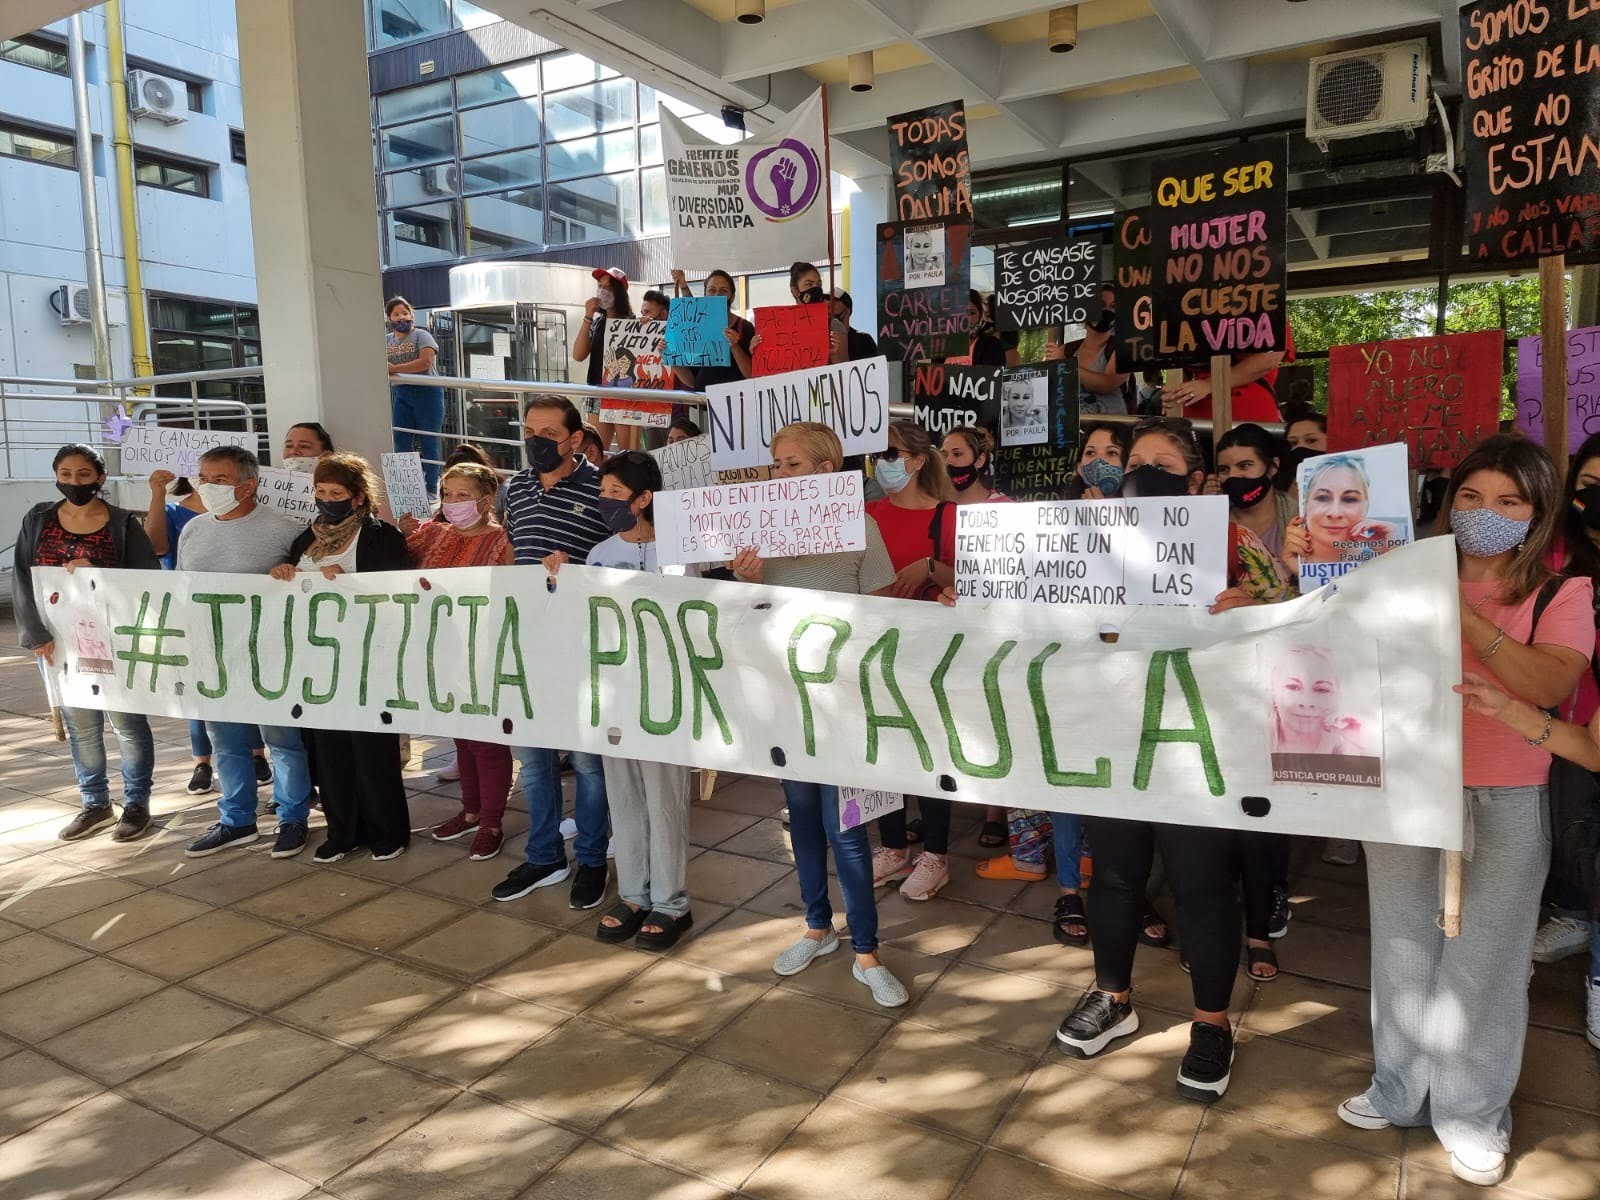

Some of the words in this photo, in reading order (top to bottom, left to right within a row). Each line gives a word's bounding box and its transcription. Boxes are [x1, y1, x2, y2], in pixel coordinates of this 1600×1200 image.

[1465, 0, 1550, 51] SOMOS
[1534, 43, 1565, 78] DE
[1473, 104, 1512, 138] QUE
[1534, 93, 1570, 126] NO
[891, 111, 965, 147] TODAS
[686, 149, 722, 161] FRENTE
[725, 149, 740, 159] DE
[897, 150, 969, 188] SOMOS
[717, 183, 740, 196] MUP
[1157, 173, 1216, 208] QUE
[1223, 160, 1273, 197] SER
[678, 196, 745, 214] DIVERSIDAD
[678, 214, 695, 228] LA
[698, 214, 755, 229] PAMPA
[1170, 210, 1267, 251] MUJER
[997, 251, 1019, 270] TE
[1022, 241, 1097, 267] CANSASTE
[1166, 253, 1204, 285] NO
[1213, 245, 1272, 282] NOS
[1000, 270, 1023, 287] DE
[1083, 264, 1095, 280] Y
[884, 287, 967, 318] CARCEL
[997, 283, 1069, 307] NOSOTRAS
[1072, 282, 1097, 299] DE
[1181, 283, 1281, 316] CUESTE
[609, 319, 622, 333] SI
[625, 321, 642, 334] UN
[879, 322, 900, 338] AL
[1158, 320, 1197, 354] LA
[608, 334, 648, 350] FALTO
[899, 338, 926, 363] YA
[1361, 346, 1393, 376] YO
[1408, 345, 1450, 371] NO
[915, 366, 944, 396] NO
[949, 370, 1001, 400] NACÍ
[1010, 370, 1042, 381] JUSTICIA
[1366, 373, 1463, 402] MUERO
[807, 362, 883, 440] MENOS
[1423, 402, 1463, 426] ME
[136, 428, 153, 444] TE
[159, 430, 221, 449] CANSAS
[1006, 429, 1020, 437] POR
[1024, 426, 1046, 435] PAULA
[1033, 445, 1052, 457] UN
[274, 479, 295, 492] QUE
[681, 491, 696, 510] SI
[702, 489, 723, 507] NO
[729, 479, 819, 505] ENTIENDES
[828, 475, 855, 497] LOS
[689, 510, 751, 532] MOTIVOS
[759, 508, 778, 528] DE
[784, 511, 801, 527] LA
[809, 500, 865, 523] MARCHA
[959, 509, 998, 528] TODAS
[1037, 507, 1069, 526] PERO
[1074, 506, 1139, 527] NINGUNO
[1163, 506, 1189, 527] NO
[682, 535, 697, 552] ES
[702, 530, 745, 549] PORQUE
[751, 529, 787, 545] ERES
[793, 526, 842, 541] PARTE
[769, 540, 844, 556] PROBLEMA
[958, 532, 1025, 553] TENEMOS
[1036, 532, 1079, 554] TIENE
[1086, 533, 1111, 553] UN
[1332, 541, 1384, 550] Recemos
[1156, 541, 1195, 565] DAN
[956, 558, 980, 575] UNA
[1034, 560, 1087, 579] AMIGO
[955, 579, 978, 598] QUE
[1032, 585, 1127, 605] ABUSADOR
[1152, 573, 1193, 596] LAS
[586, 595, 733, 746] POR
[787, 612, 1227, 797] PAULA
[1315, 771, 1337, 782] POR
[1338, 774, 1381, 785] PAULA!!
